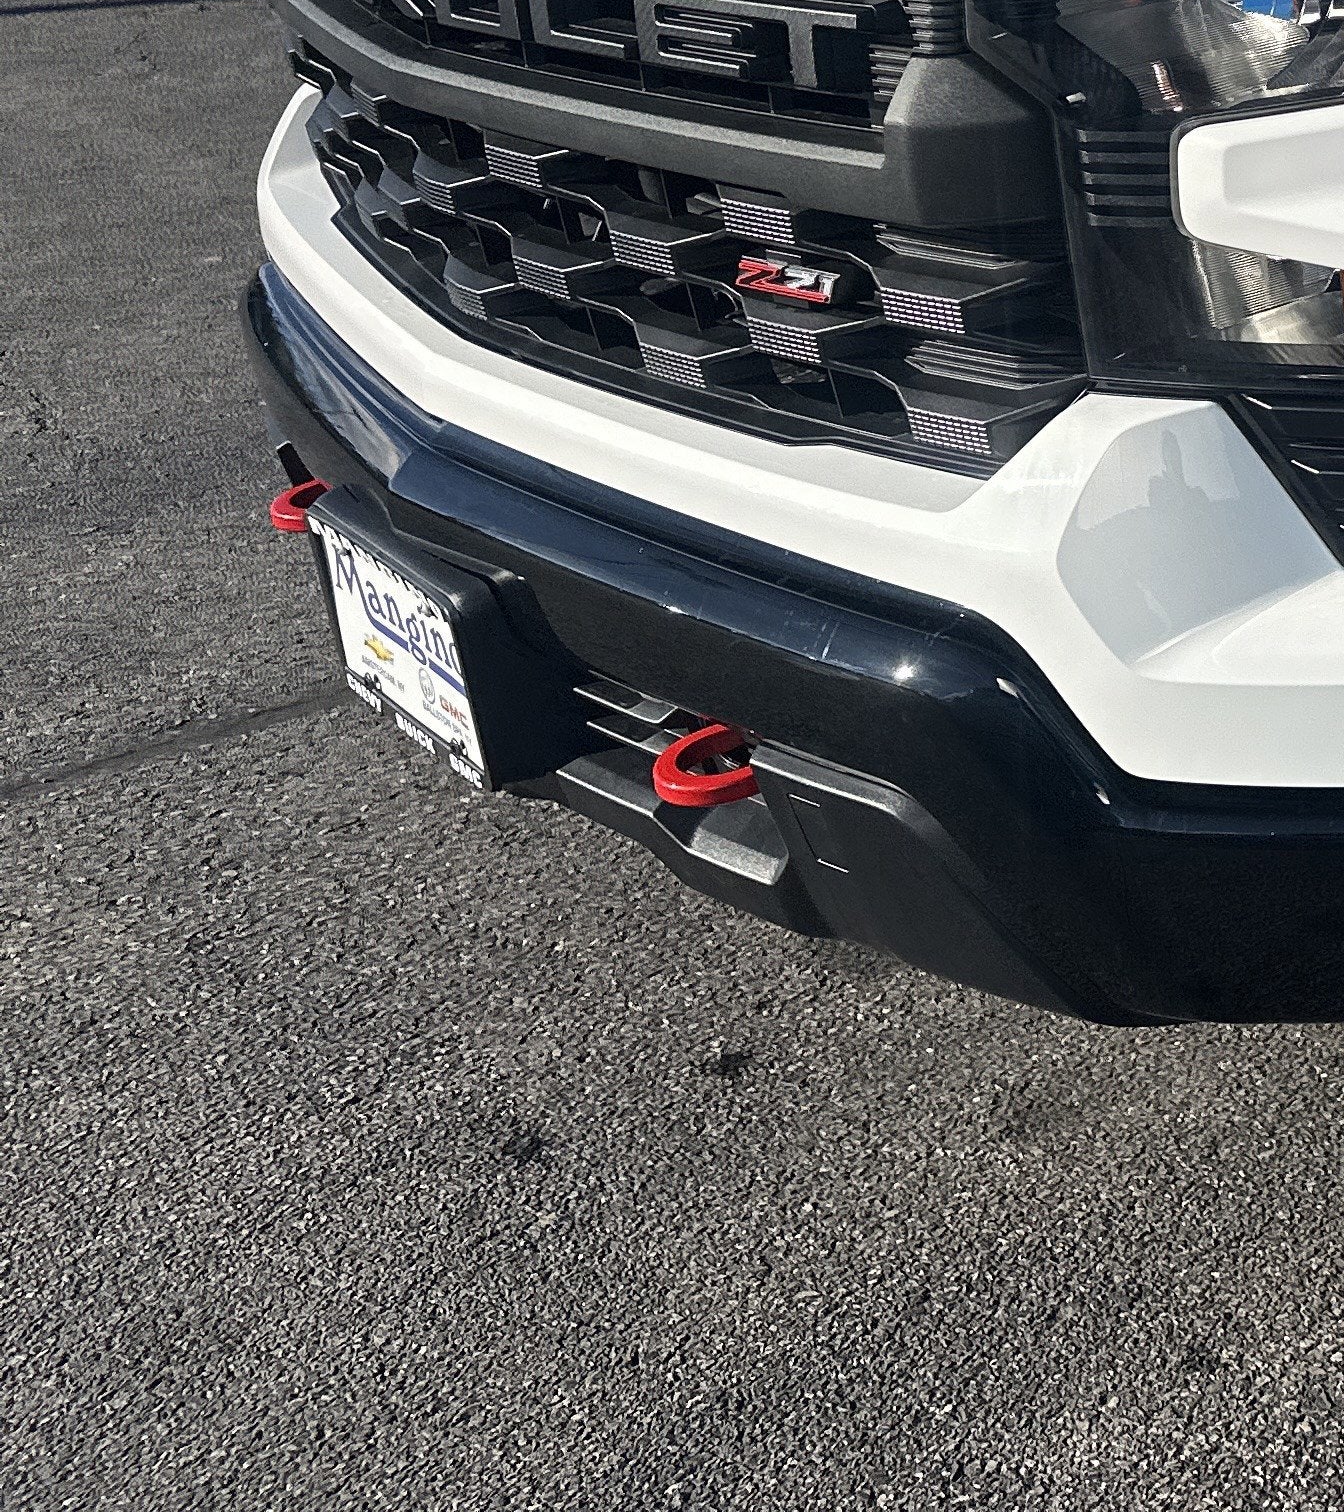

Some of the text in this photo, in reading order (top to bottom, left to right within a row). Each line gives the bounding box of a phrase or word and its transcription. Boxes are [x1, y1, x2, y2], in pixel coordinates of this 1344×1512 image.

[735, 254, 841, 305] Z71
[346, 672, 484, 790] CHEVY BUICK GMC
[439, 694, 470, 731] GMC
